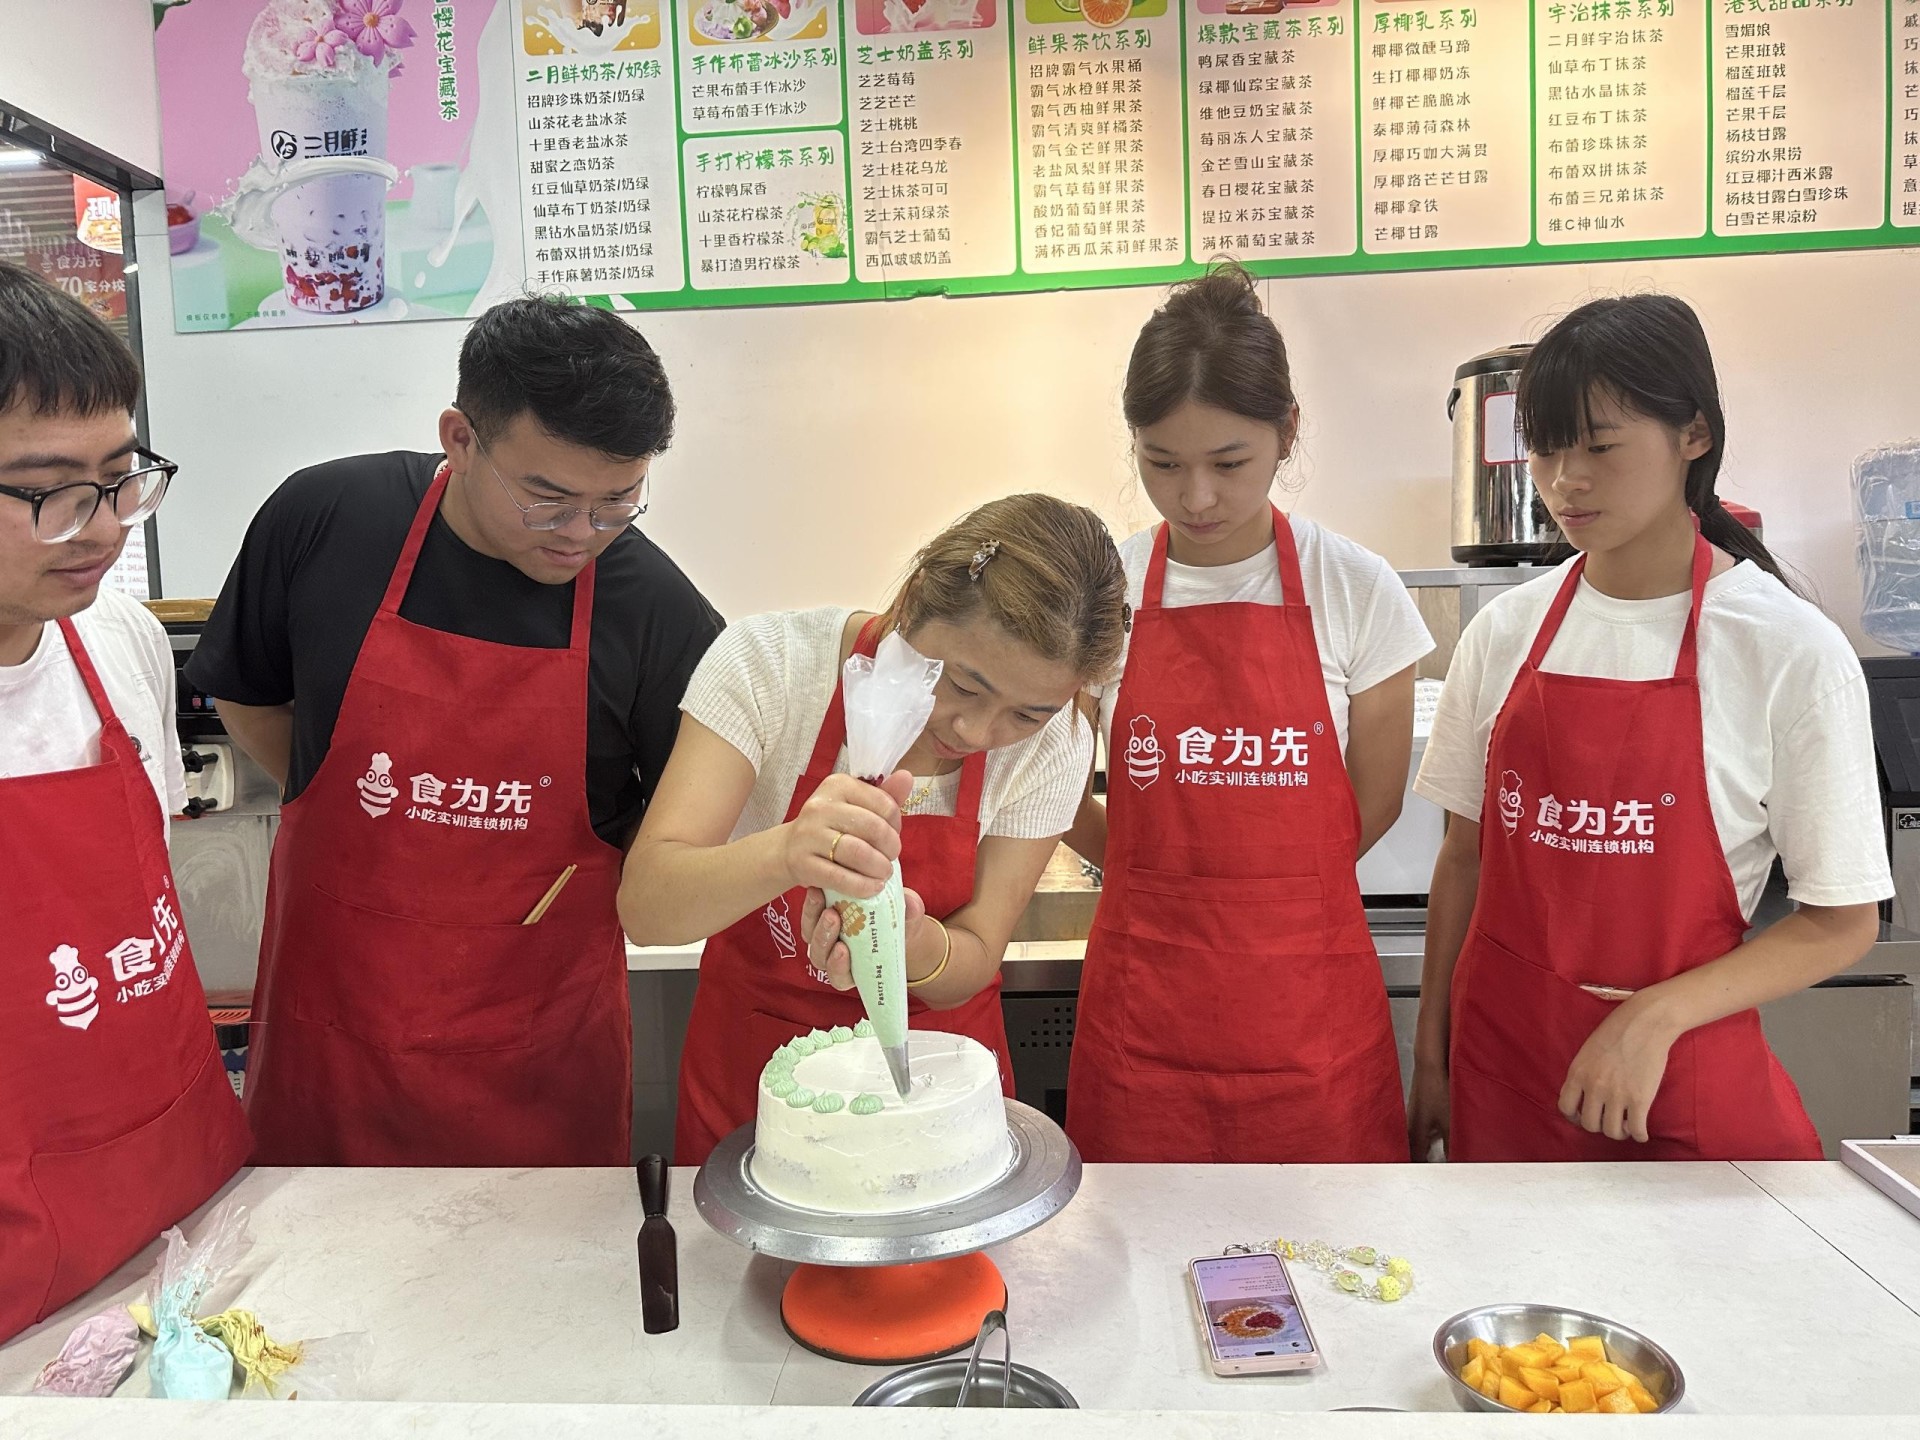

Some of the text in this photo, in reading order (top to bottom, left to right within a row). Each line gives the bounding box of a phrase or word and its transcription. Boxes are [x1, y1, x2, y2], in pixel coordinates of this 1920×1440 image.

[1373, 8, 1478, 33] 厚椰乳系列
[1548, 0, 1675, 23] 宇治抹茶系列
[1198, 15, 1344, 44] 爆款宝藏茶系列
[1548, 28, 1664, 48] 二月鲜宇治抹茶
[1726, 23, 1771, 38] 雪媚娘
[1028, 29, 1152, 55] 鲜果茶饮系列
[1372, 39, 1470, 58] 椰椰微醺马蹄
[1726, 43, 1786, 59] 芒果班戟
[1904, 37, 1920, 50] 巧
[433, 0, 458, 120] 樱花宝藏茶
[691, 47, 837, 75] 手作布蕾冰沙系列
[857, 39, 974, 65] 芝士奶盖系列
[1198, 50, 1296, 68] 鸭屎香宝藏茶
[526, 60, 662, 84] 二月鲜奶茶/奶绿
[1030, 58, 1142, 78] 招牌霸气水果桶
[1549, 56, 1647, 75] 仙草布丁抹茶
[1726, 63, 1786, 80] 榴莲班戟
[858, 72, 915, 88] 芝芝莓莓
[1199, 75, 1312, 94] 绿椰仙踪宝藏茶
[1372, 66, 1470, 85] 生打椰椰奶冻
[692, 79, 806, 98] 芒果布蕾手作冰沙
[1031, 78, 1142, 98] 霸气冰橙鲜果茶
[1549, 82, 1647, 101] 黑钻水晶抹茶
[1726, 85, 1786, 101] 榴莲千层
[527, 89, 645, 108] 招牌珍珠奶茶/奶绿
[859, 95, 916, 110] 芝芝芒芒
[1373, 92, 1471, 111] 鲜椰芒脆脆冰
[693, 102, 807, 120] 草莓布蕾手作冰沙
[1031, 99, 1142, 118] 霸气西柚鲜果茶
[1200, 101, 1313, 120] 维他豆奶宝藏茶
[1549, 108, 1647, 127] 红豆布丁抹茶
[1726, 106, 1786, 122] 芒果千层
[529, 112, 627, 130] 山茶花老盐冰茶
[860, 117, 918, 132] 芝士桃桃
[1032, 119, 1143, 138] 霸气清爽鲜橘茶
[1373, 118, 1470, 137] 泰椰薄荷森林
[530, 134, 629, 152] 十里香老盐冰茶
[1201, 127, 1313, 146] 莓丽冻人宝藏茶
[1549, 134, 1648, 153] 布蕾珍珠抹茶
[1726, 127, 1787, 143] 杨枝甘露
[861, 137, 962, 155] 芝士台湾四季春
[1033, 139, 1143, 158] 霸气金芒鲜果茶
[1373, 143, 1488, 163] 厚椰巧咖大满贯
[1726, 146, 1801, 164] 缤纷水果捞
[530, 157, 615, 174] 甜蜜之恋奶茶
[695, 146, 835, 172] 手打柠檬茶系列
[862, 159, 948, 177] 芝士桂花乌龙
[1033, 159, 1144, 178] 老盐凤梨鲜果茶
[1201, 153, 1314, 172] 金芒雪山宝藏茶
[1904, 154, 1920, 169] 草
[1373, 170, 1488, 189] 厚椰路芒芒甘露
[1549, 161, 1648, 180] 布蕾双拼抹茶
[1726, 166, 1833, 184] 红豆椰汁西米露
[532, 176, 649, 196] 红豆仙草奶茶/奶绿
[696, 182, 767, 198] 柠檬鸭屎香
[863, 182, 948, 200] 芝士抹茶可可
[1033, 179, 1145, 198] 霸气草莓鲜果茶
[1202, 179, 1314, 197] 春日樱花宝藏茶
[1904, 178, 1920, 193] 意
[1549, 186, 1664, 206] 布蕾三兄弟抹茶
[1726, 187, 1849, 205] 杨枝甘露白雪珍珠
[87, 196, 121, 221] 现
[533, 199, 650, 218] 仙草布丁奶茶/奶绿
[698, 206, 783, 224] 山茶花柠檬茶
[864, 204, 949, 223] 芝士茉莉绿茶
[1033, 199, 1145, 218] 酸奶葡萄鲜果茶
[1202, 205, 1315, 224] 提拉米苏宝藏茶
[1375, 199, 1438, 215] 椰椰拿铁
[1903, 202, 1920, 216] 提
[1549, 216, 1625, 232] 维C神仙水
[1726, 208, 1817, 227] 白雪芒果凉粉
[534, 221, 652, 240] 黑钻水晶奶茶/奶绿
[865, 228, 950, 246] 霸气芝士葡萄
[1035, 219, 1145, 238] 香妃葡萄鲜果茶
[1375, 224, 1438, 241] 芒椰甘露
[699, 231, 784, 247] 十里香柠檬茶
[1035, 238, 1178, 259] 满杯西瓜茉莉鲜果茶
[1203, 231, 1315, 250] 满杯葡萄宝藏茶
[536, 243, 653, 262] 布蕾双拼奶茶/奶绿
[866, 250, 951, 267] 西瓜啵啵奶盖
[701, 255, 800, 273] 暴打渣男柠檬茶
[537, 265, 654, 283] 手作麻薯奶茶/奶绿
[1175, 726, 1309, 767] 食为先
[1174, 769, 1309, 787] 小吃实训连锁机构
[409, 772, 532, 814] 食为先
[404, 805, 529, 831] 小吃实训连锁机构
[1536, 793, 1654, 836] 食为先
[1529, 829, 1654, 854] 小吃实训连锁机构
[868, 910, 880, 954] Pastry bag
